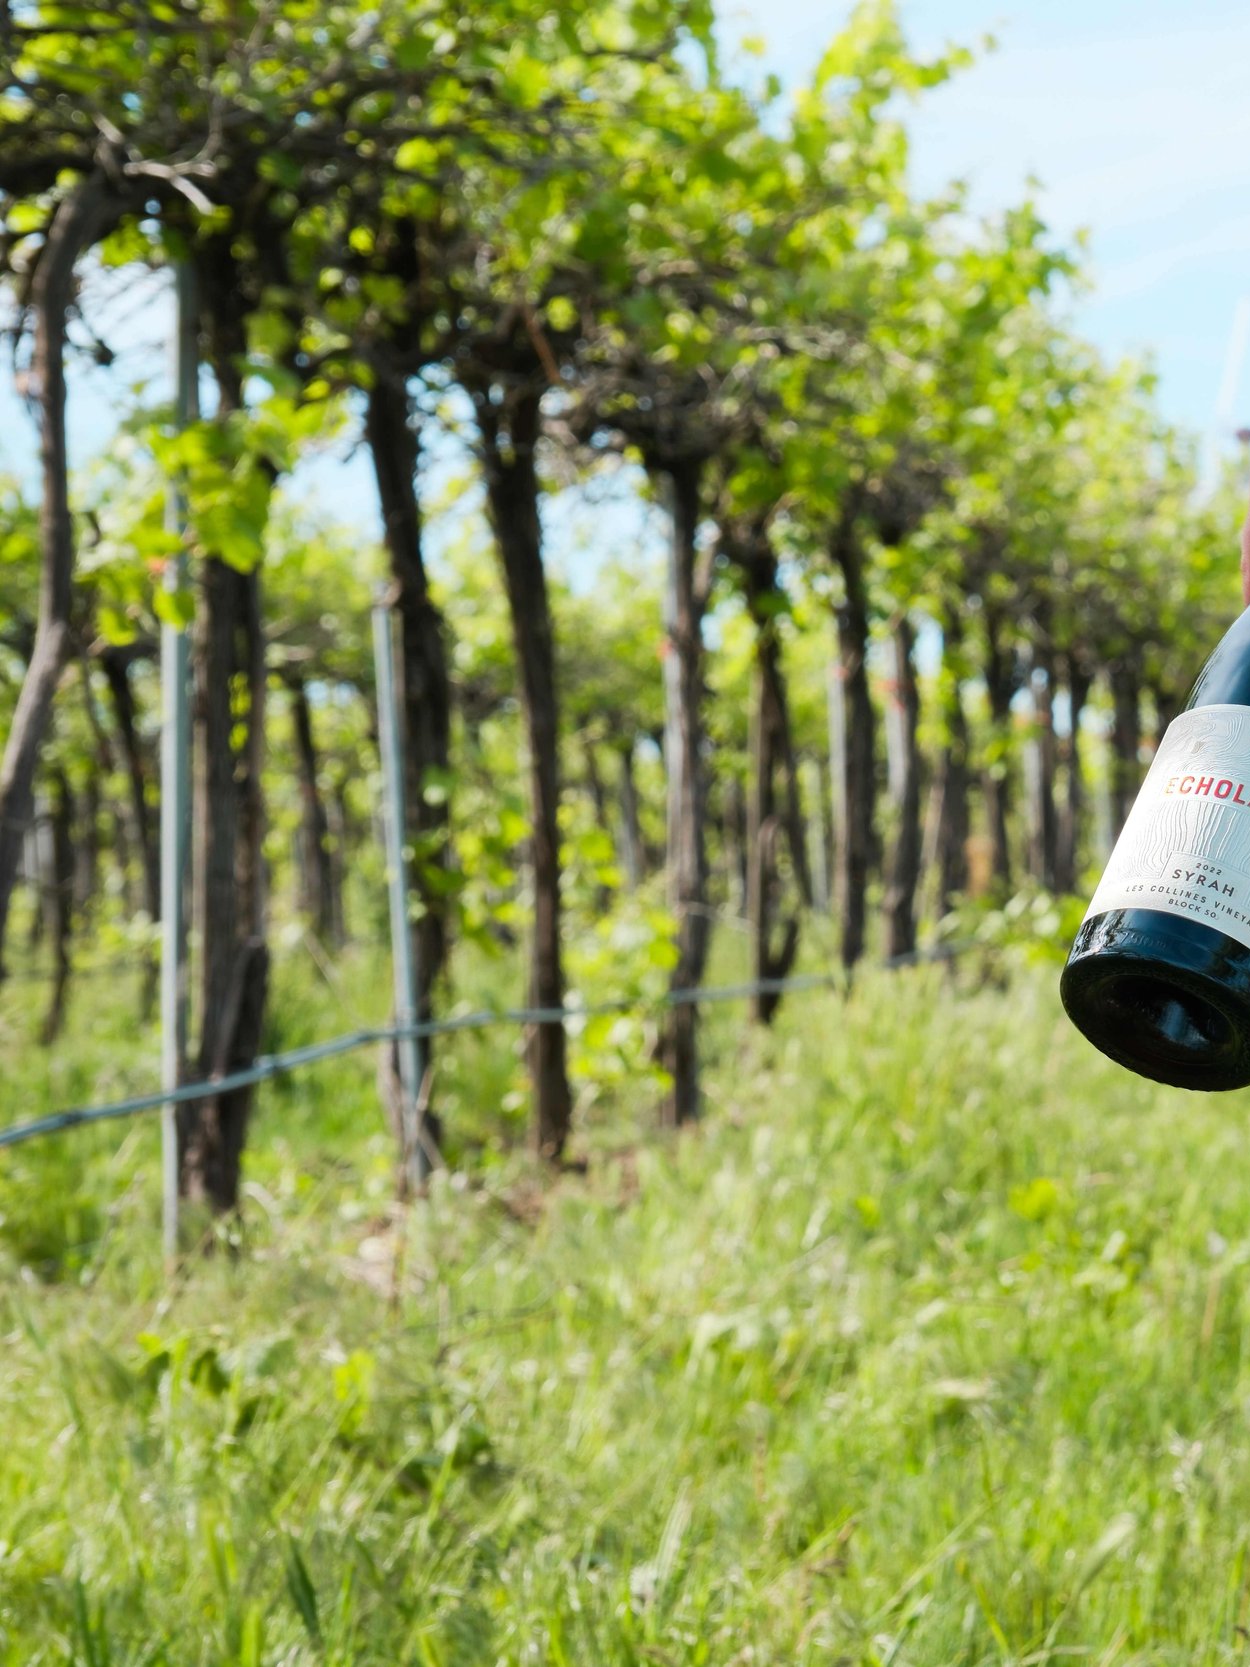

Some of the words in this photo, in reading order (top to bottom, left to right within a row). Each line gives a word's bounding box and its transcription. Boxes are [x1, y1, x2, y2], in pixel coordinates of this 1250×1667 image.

[1195, 862, 1223, 876] 2022
[1171, 868, 1236, 897] SYRAH
[1125, 884, 1144, 893] LES
[1150, 885, 1207, 904] COLLINES
[1168, 898, 1201, 913] BLOCK
